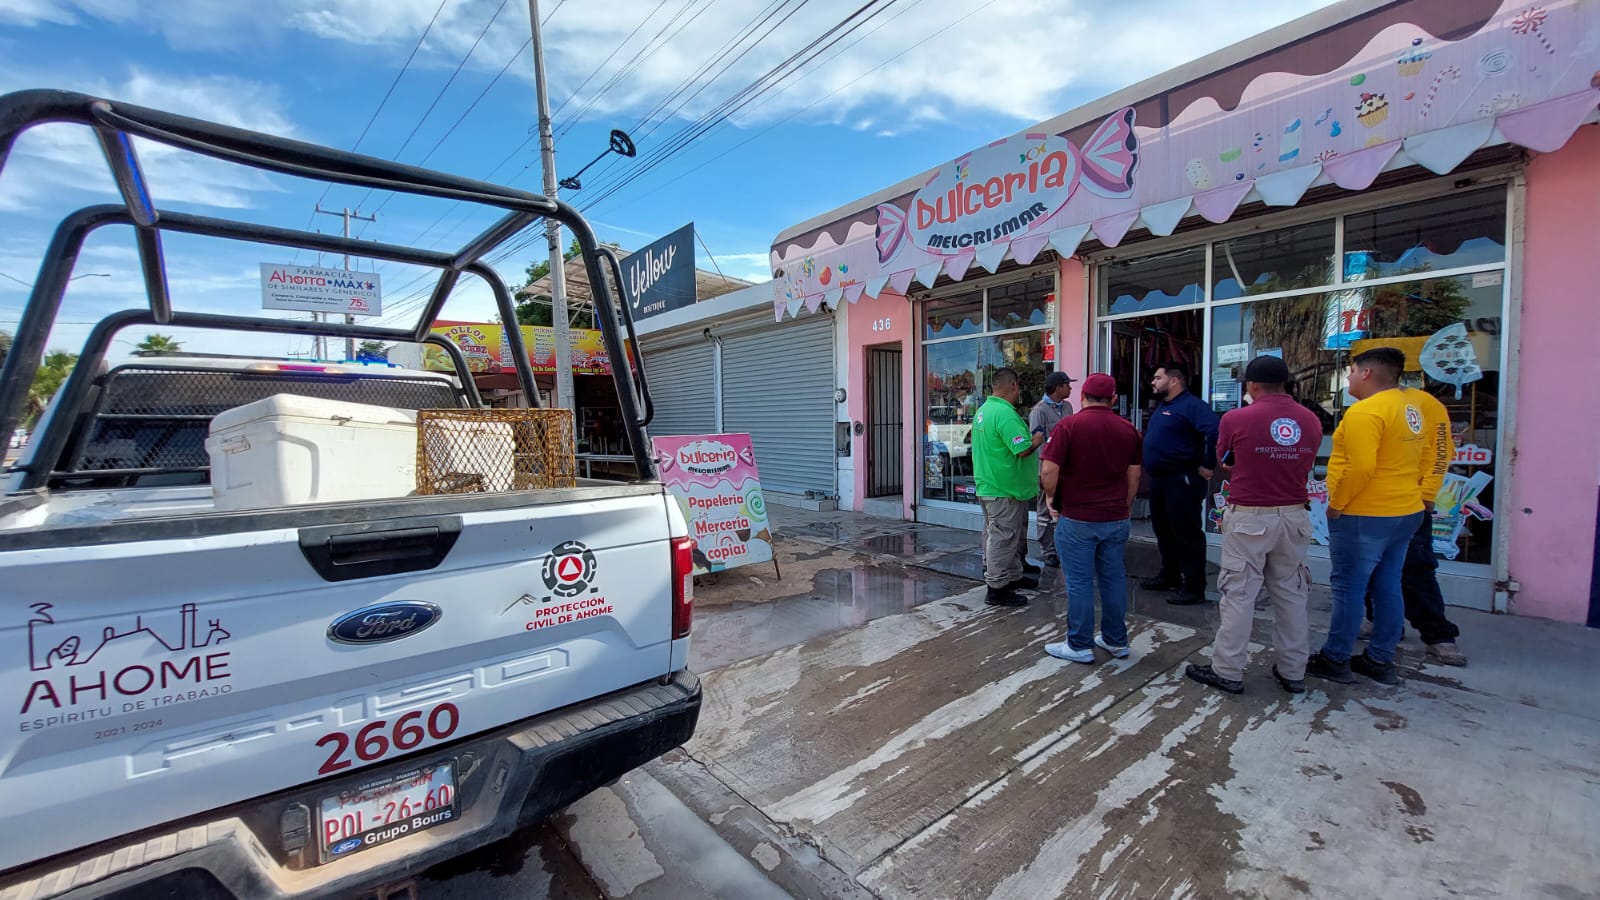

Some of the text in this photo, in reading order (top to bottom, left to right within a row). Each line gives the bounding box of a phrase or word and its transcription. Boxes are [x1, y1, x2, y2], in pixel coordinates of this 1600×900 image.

[927, 201, 1049, 249] MELCRISMAR
[269, 270, 326, 287] Ahorra
[296, 268, 354, 280] FARMACIAS
[630, 244, 677, 309] Yellow
[280, 284, 323, 293] SIMILARES
[872, 317, 891, 332] 436
[1269, 452, 1301, 460] AHOME
[695, 515, 749, 534] Mercería
[707, 543, 747, 560] copias
[525, 605, 614, 631] CIVIL DE AHOME
[535, 597, 605, 618] PROTECCIÓN
[355, 610, 420, 639] Ford
[19, 651, 232, 714] AHOME
[19, 684, 233, 732] ESPÍRITU DE TRABAJO
[95, 718, 163, 740] 2021 2024
[315, 702, 460, 776] 2660
[364, 823, 409, 844] Grupo
[412, 810, 453, 829] Bours
